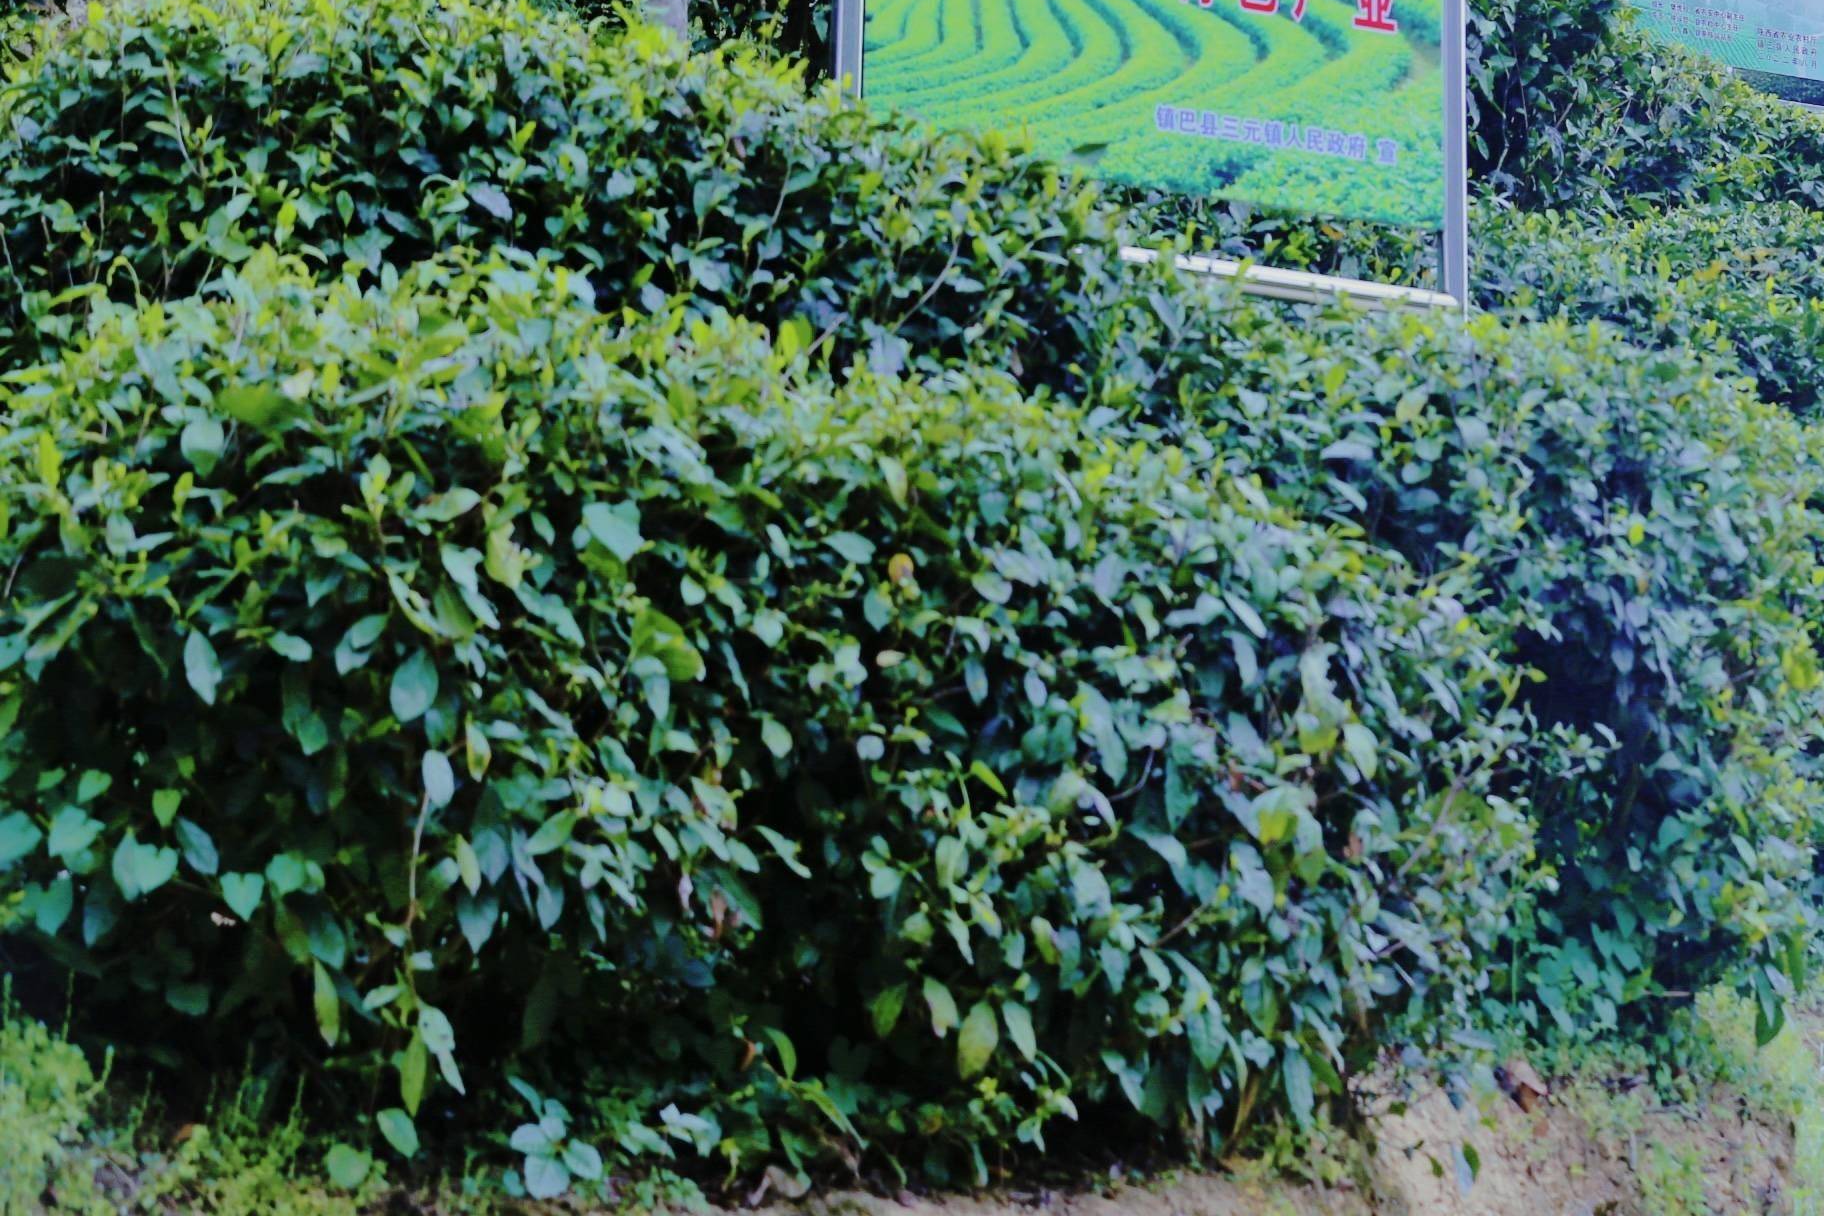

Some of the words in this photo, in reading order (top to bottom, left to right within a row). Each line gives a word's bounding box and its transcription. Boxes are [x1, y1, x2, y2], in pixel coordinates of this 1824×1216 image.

[1156, 104, 1367, 161] 镇巴县三元镇人民政府
[1377, 138, 1397, 165] 宣
